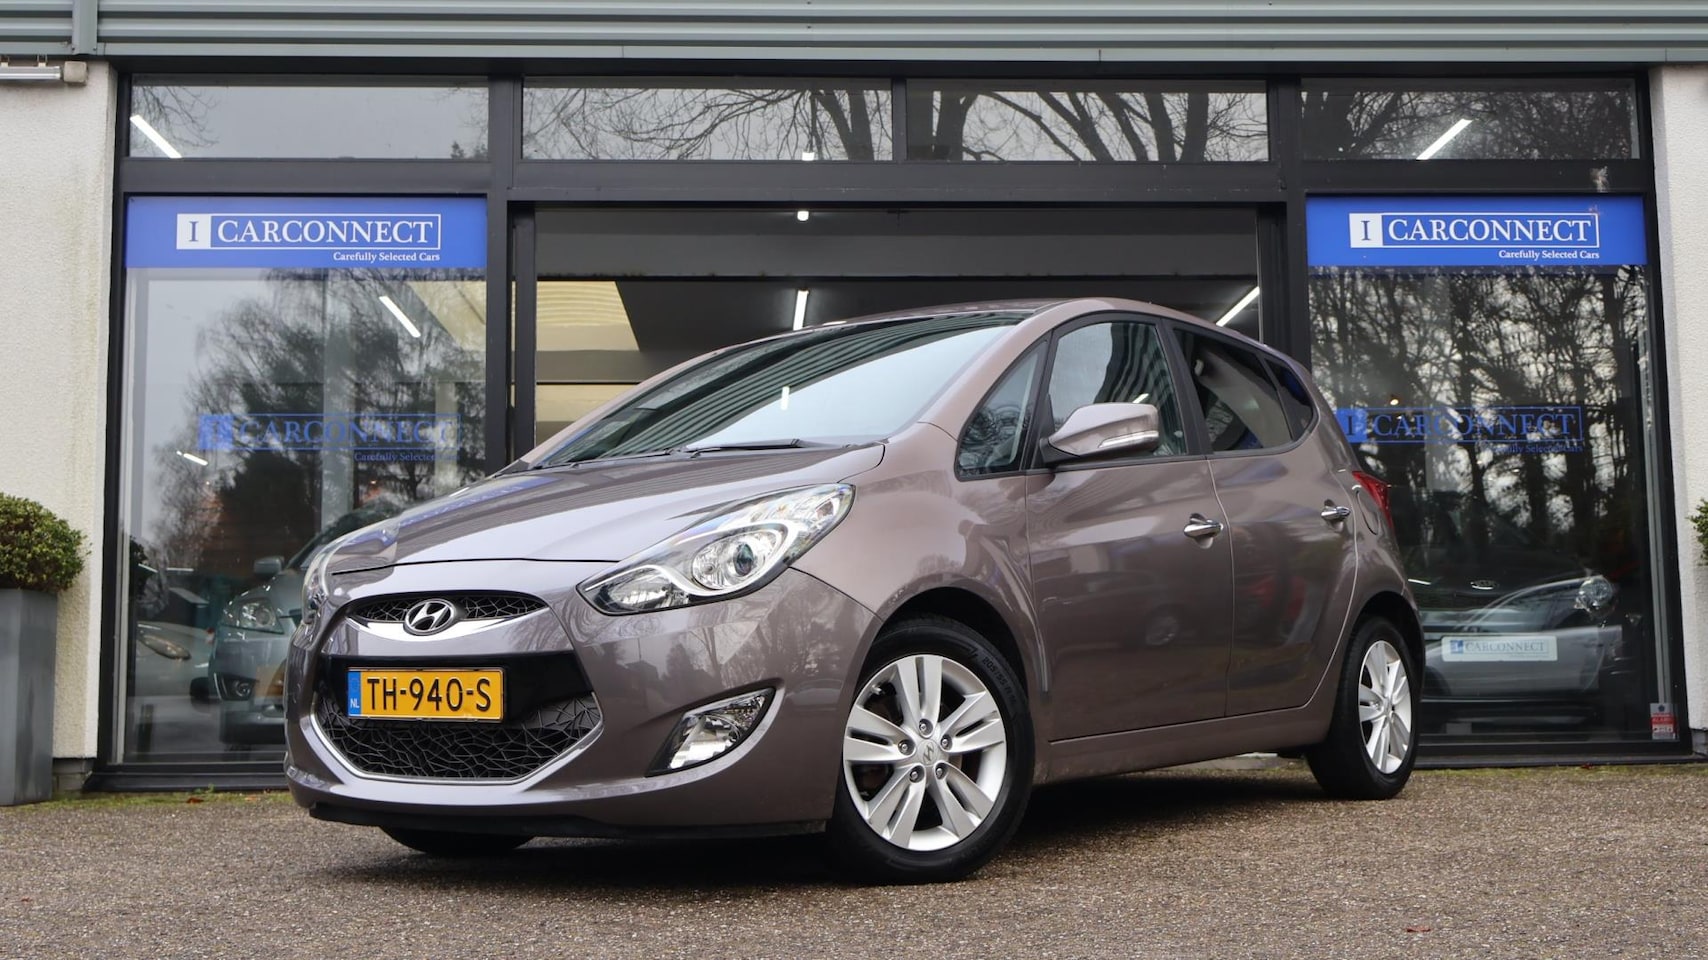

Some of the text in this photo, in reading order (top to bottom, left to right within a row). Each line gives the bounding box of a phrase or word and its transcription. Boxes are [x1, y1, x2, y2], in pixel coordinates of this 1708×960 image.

[217, 220, 433, 243] CARCONNECT
[1388, 219, 1591, 242] CARCONNECT
[332, 251, 441, 264] Carefully Selected Cars
[1498, 249, 1600, 261] Carefully Selected Cars
[1373, 413, 1574, 437] CARCONNECT
[353, 450, 398, 463] Carefully
[1465, 640, 1545, 652] CARCONNECT
[367, 676, 491, 712] TH-940-S
[350, 698, 360, 708] NL
